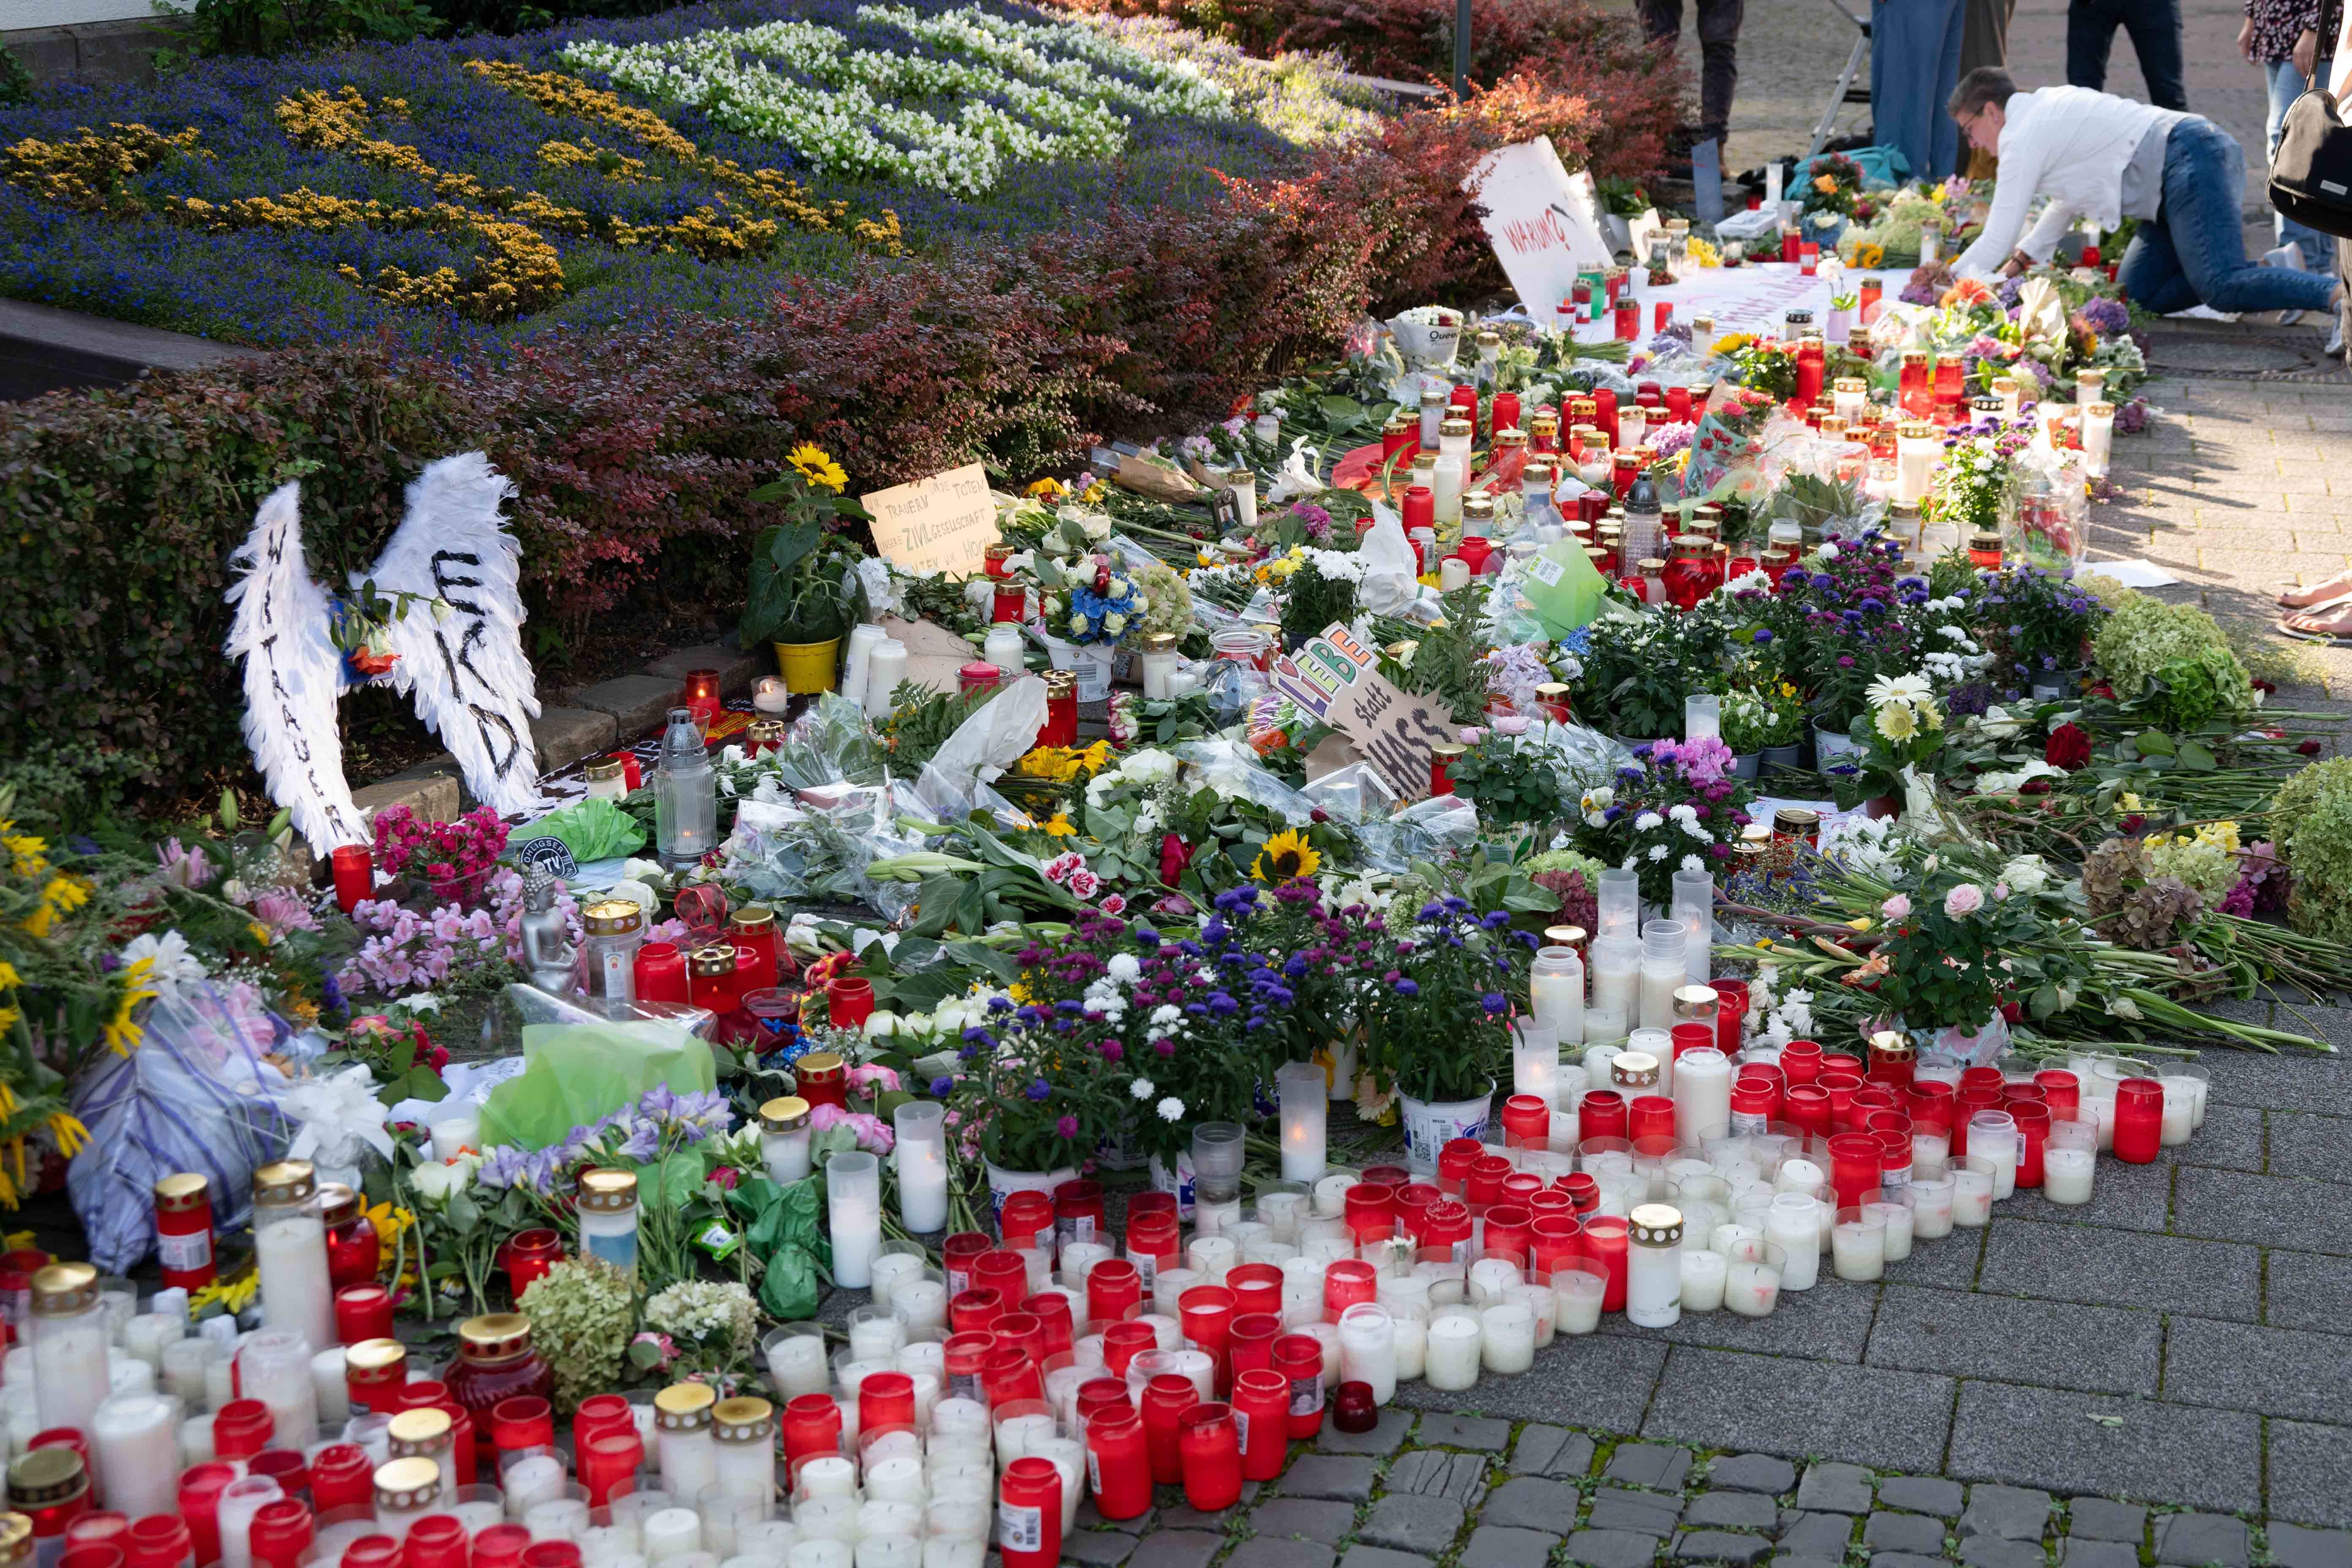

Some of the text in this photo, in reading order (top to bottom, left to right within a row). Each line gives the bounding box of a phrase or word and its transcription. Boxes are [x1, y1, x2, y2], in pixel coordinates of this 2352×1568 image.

[1502, 208, 1571, 254] WARUM?
[866, 496, 882, 511] WIR
[885, 494, 929, 520] TRAUERN
[952, 478, 984, 499] TOTEN
[879, 508, 986, 553] UNSERE ZIVILGESELLSCHAFT
[1277, 629, 1372, 718] LIEBE
[1353, 681, 1393, 730] statt
[1367, 708, 1454, 797] HASS
[524, 840, 564, 863] OHLIGSER
